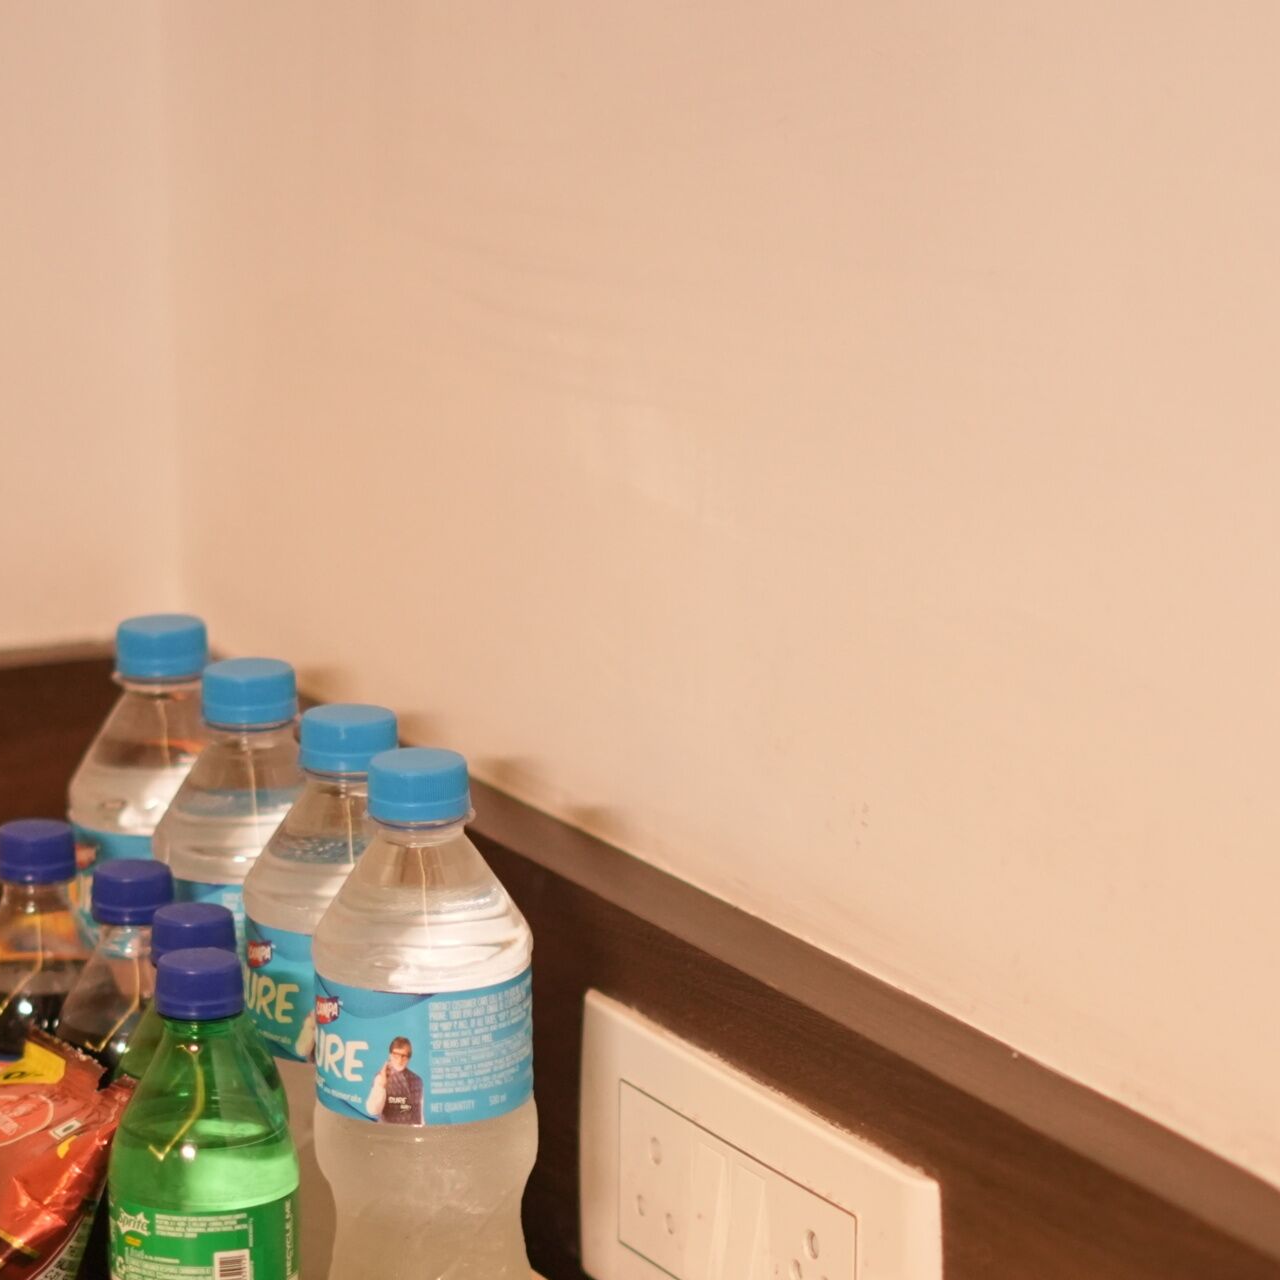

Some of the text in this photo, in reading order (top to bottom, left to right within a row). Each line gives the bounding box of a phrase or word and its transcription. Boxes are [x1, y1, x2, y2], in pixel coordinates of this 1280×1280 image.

[244, 966, 300, 1023] URE
[315, 1029, 369, 1083] URE
[431, 1101, 444, 1113] NET
[444, 1099, 475, 1112] QUANTITY
[118, 1209, 149, 1233] Sprite
